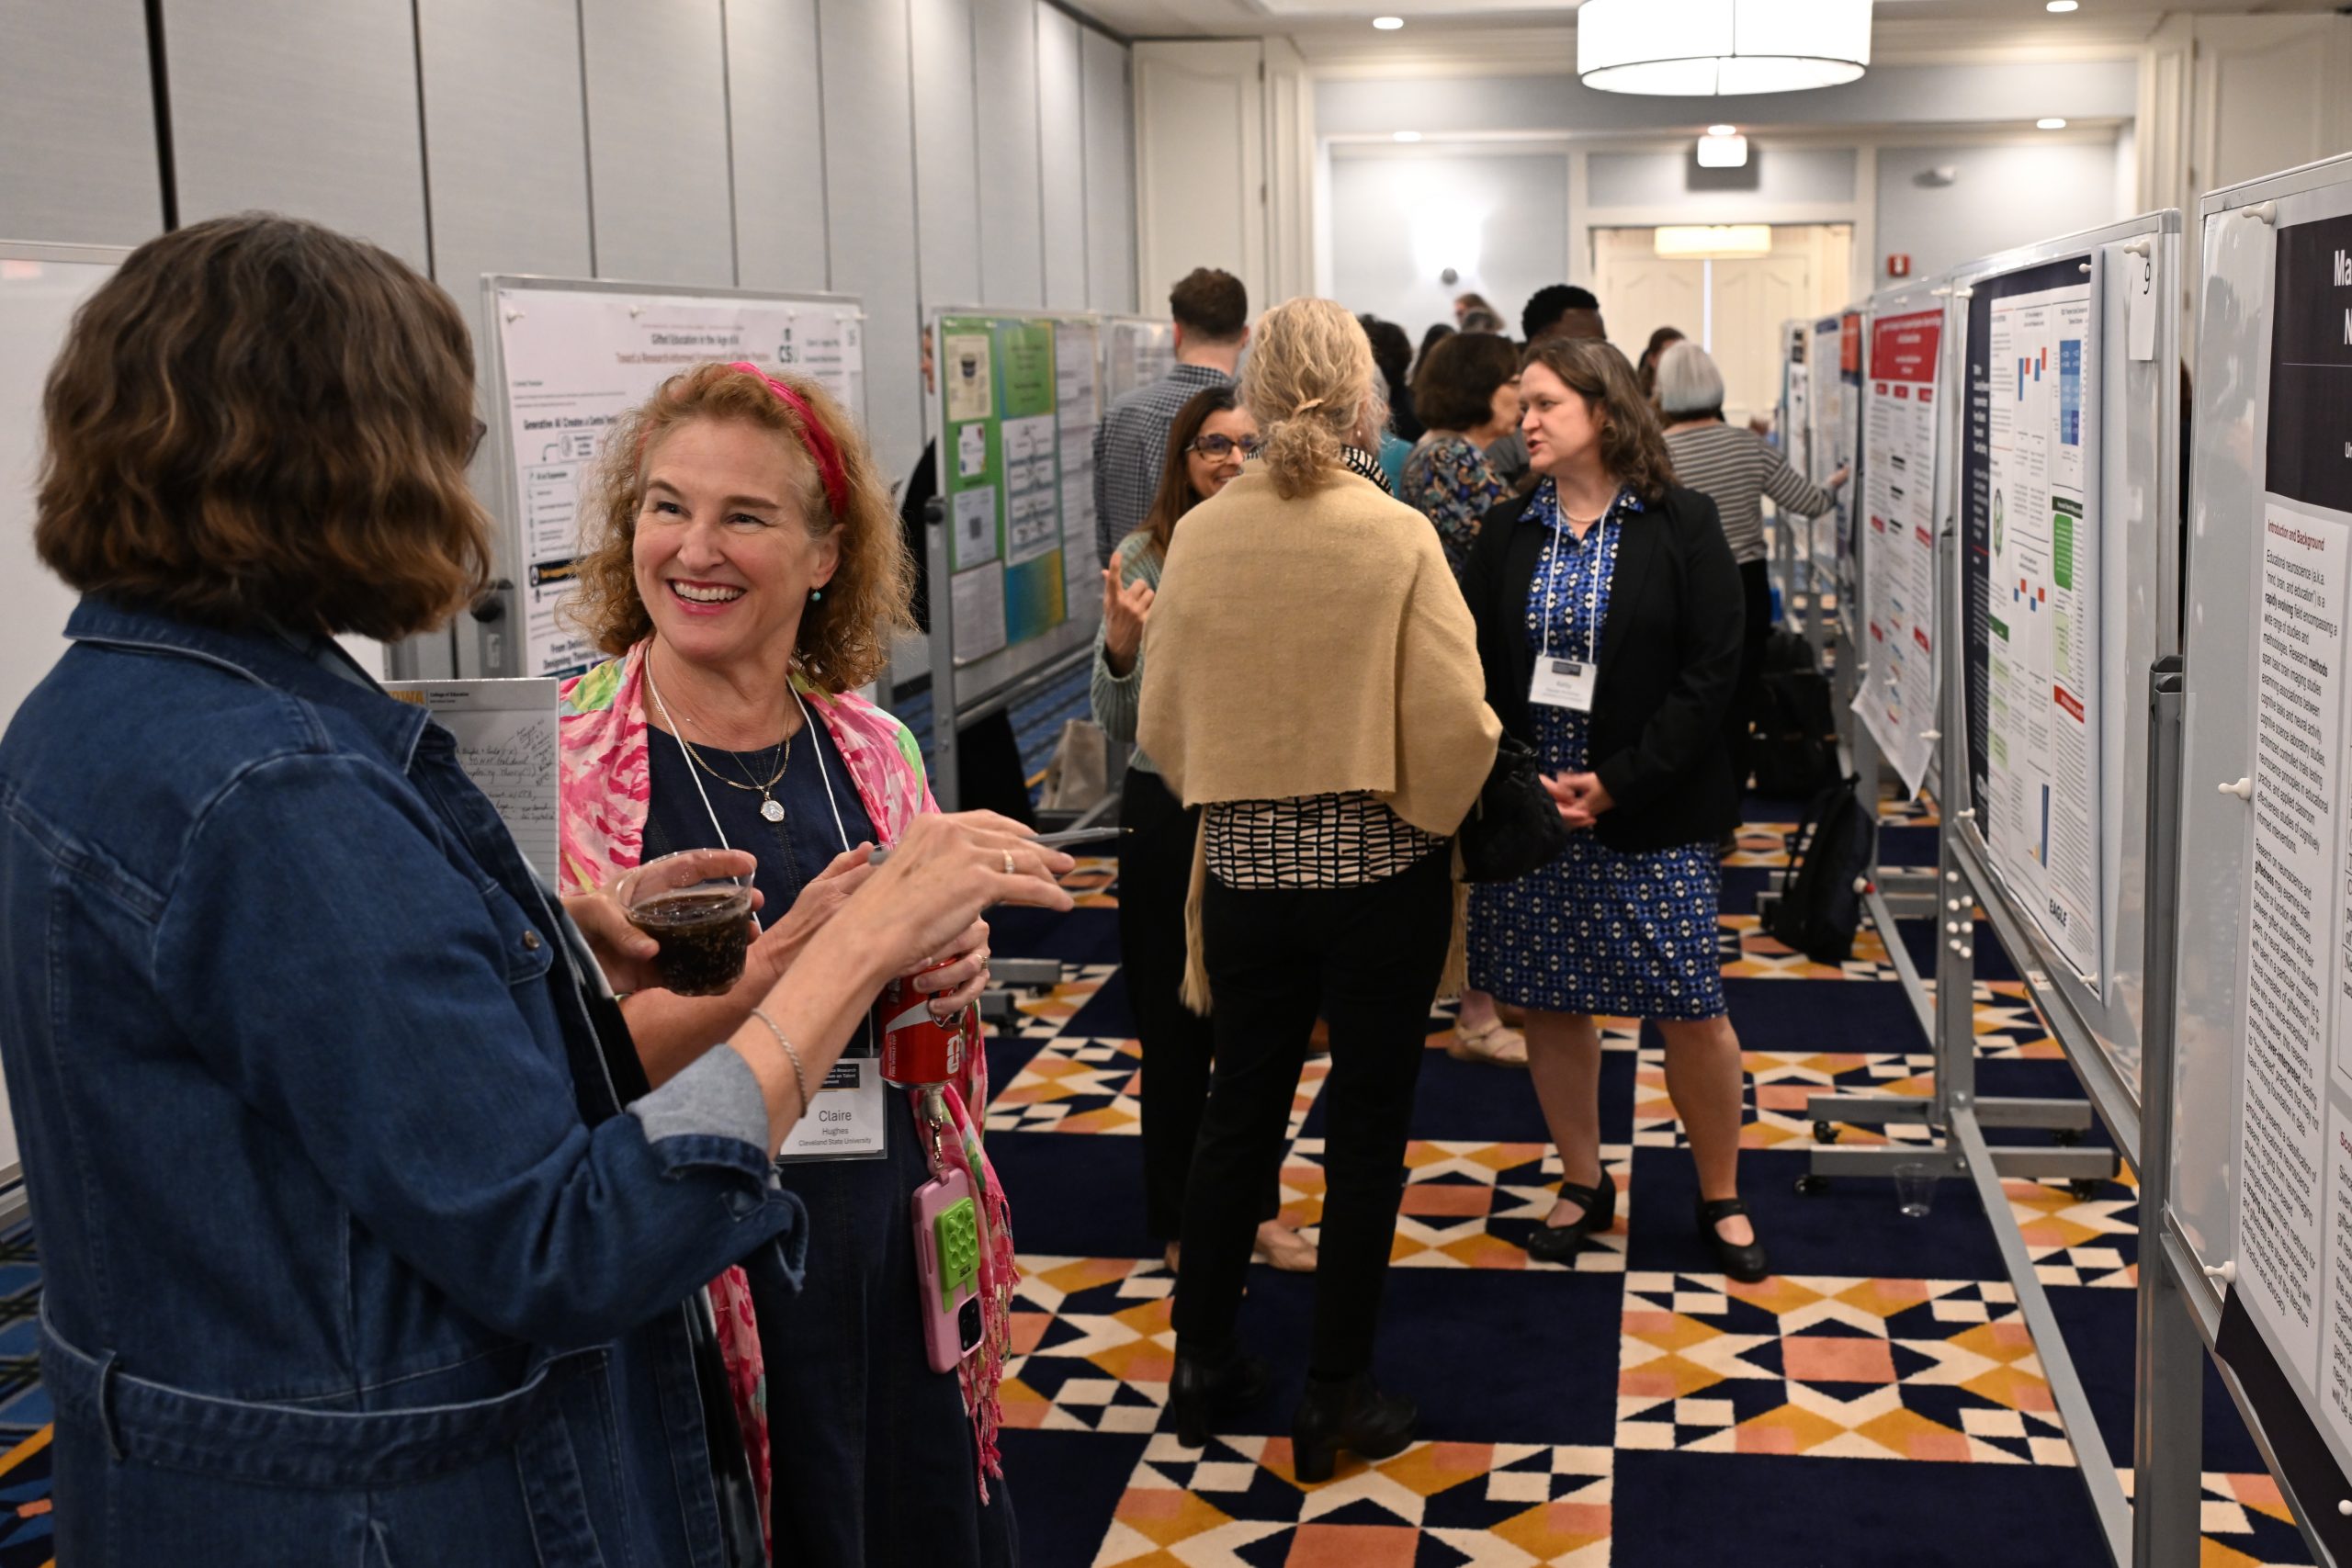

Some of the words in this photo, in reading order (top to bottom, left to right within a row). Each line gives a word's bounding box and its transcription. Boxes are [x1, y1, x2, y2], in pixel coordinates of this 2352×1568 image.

[2268, 520, 2288, 538] Introduction
[2297, 530, 2324, 551] Background
[2267, 550, 2285, 570] Educational
[2287, 561, 2311, 580] neuroscience
[2266, 593, 2277, 611] rapidly
[2278, 599, 2293, 619] evolving
[2294, 604, 2302, 619] field
[2303, 612, 2333, 638] encompassing
[2274, 618, 2282, 634] range
[2287, 624, 2301, 640] studies
[2263, 654, 2271, 668] span
[2272, 656, 2280, 672] basic
[2281, 661, 2290, 678] brain
[2290, 667, 2306, 692] imaging
[2307, 678, 2321, 696] studies
[2290, 644, 2308, 666] Research
[2309, 659, 2328, 677] methods
[2262, 674, 2278, 696] examining
[2280, 685, 2302, 707] associations
[2303, 695, 2320, 718] between
[2050, 899, 2067, 927] EAGLE
[819, 1111, 852, 1122] Claire
[822, 1128, 849, 1136] Hughes
[2335, 1345, 2346, 1368] gaps
[2333, 1366, 2348, 1397] nearly
